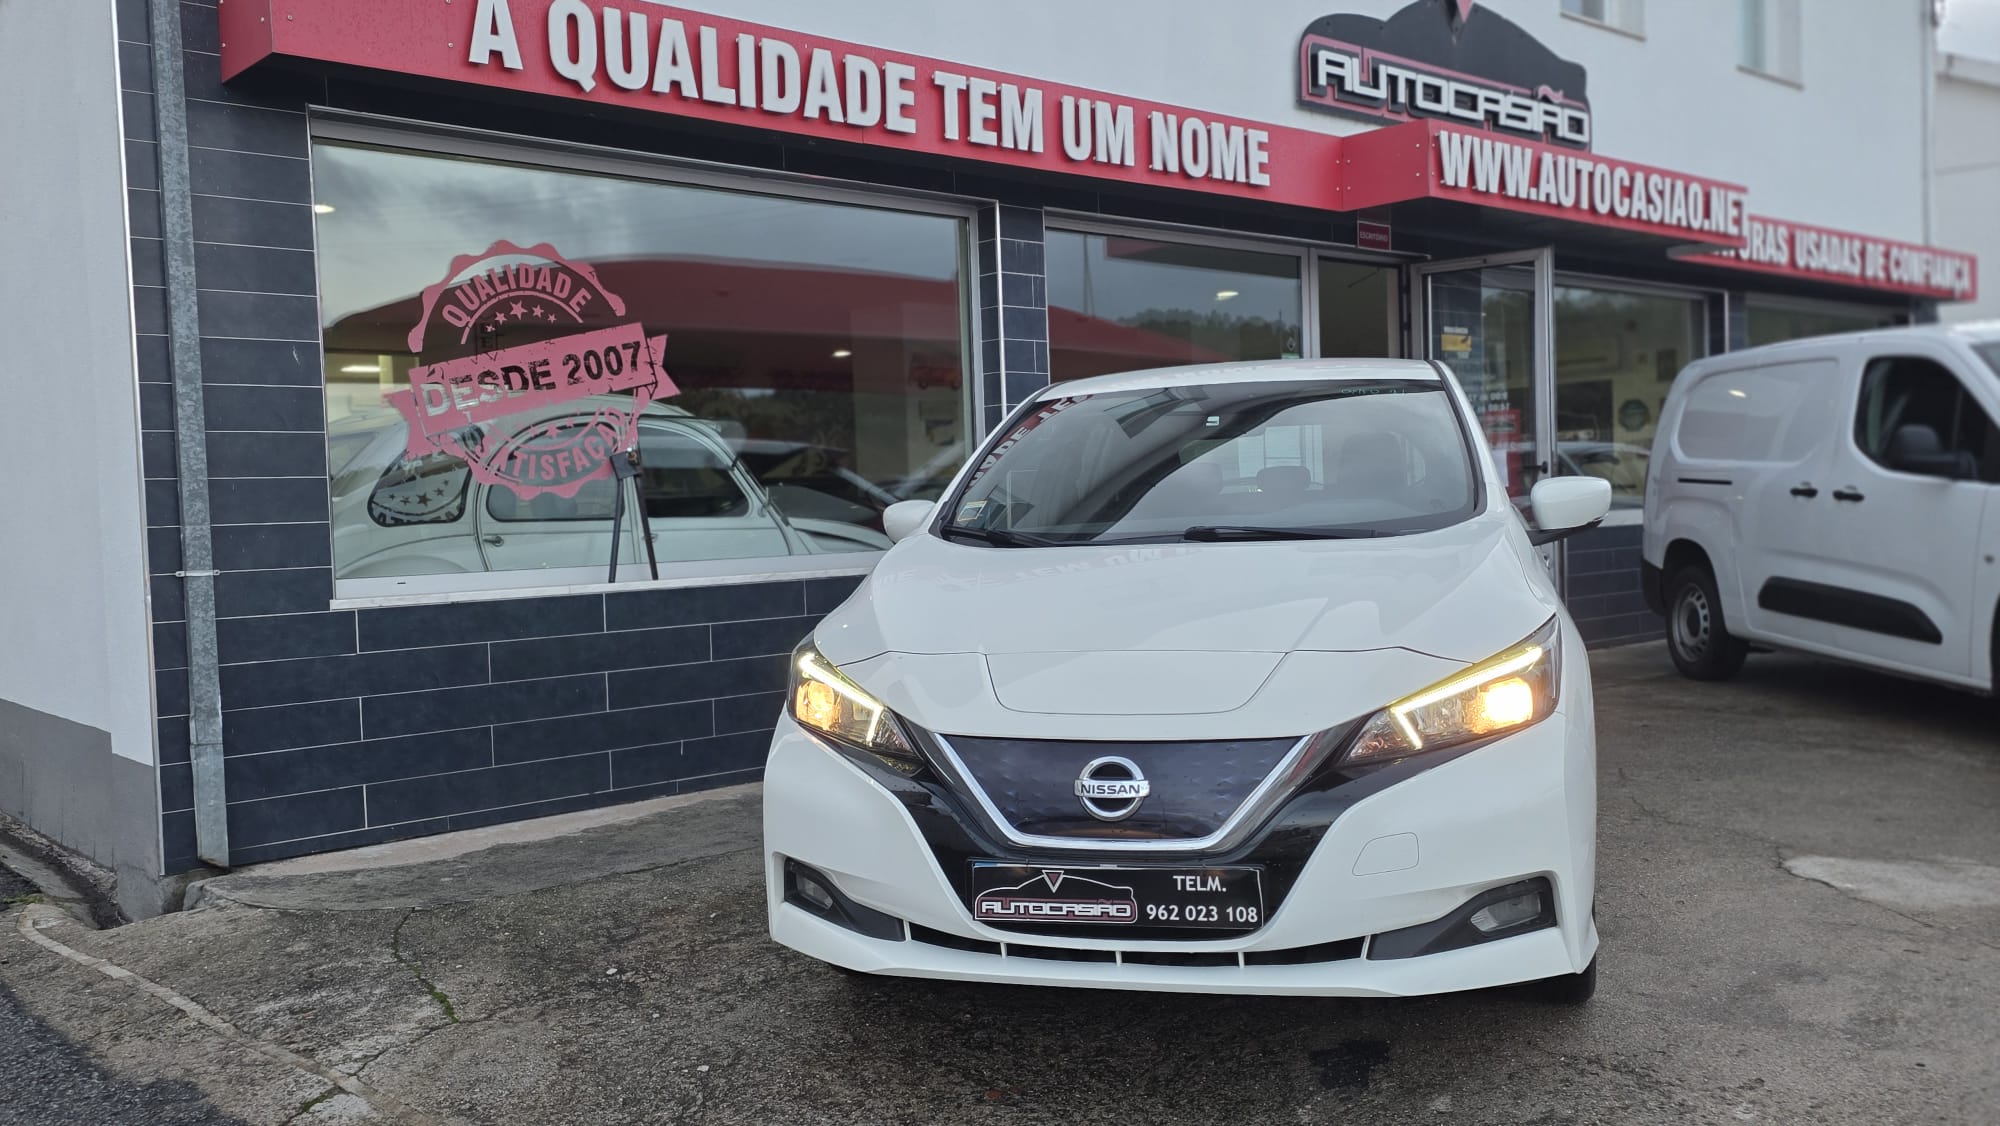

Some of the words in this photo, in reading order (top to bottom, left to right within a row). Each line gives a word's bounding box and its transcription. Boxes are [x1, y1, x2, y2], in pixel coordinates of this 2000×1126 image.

[469, 0, 523, 70] A
[548, 0, 916, 134] QUALIDADE
[934, 71, 1043, 153] TEM
[1061, 95, 1135, 167] UM
[1151, 111, 1270, 186] NOME
[1440, 130, 1749, 238] WWW.AUTOCASIAO.NET
[1795, 228, 1863, 276] USADAS
[1865, 242, 1888, 280] DE
[442, 263, 592, 328] QUALIDADE
[421, 360, 556, 417] DESDE
[562, 341, 641, 386] 2007
[1081, 784, 1140, 795] NISSAN
[1173, 875, 1227, 892] TELM.
[1146, 904, 1180, 921] 962
[1186, 905, 1218, 922] 023
[1226, 907, 1258, 923] 108
